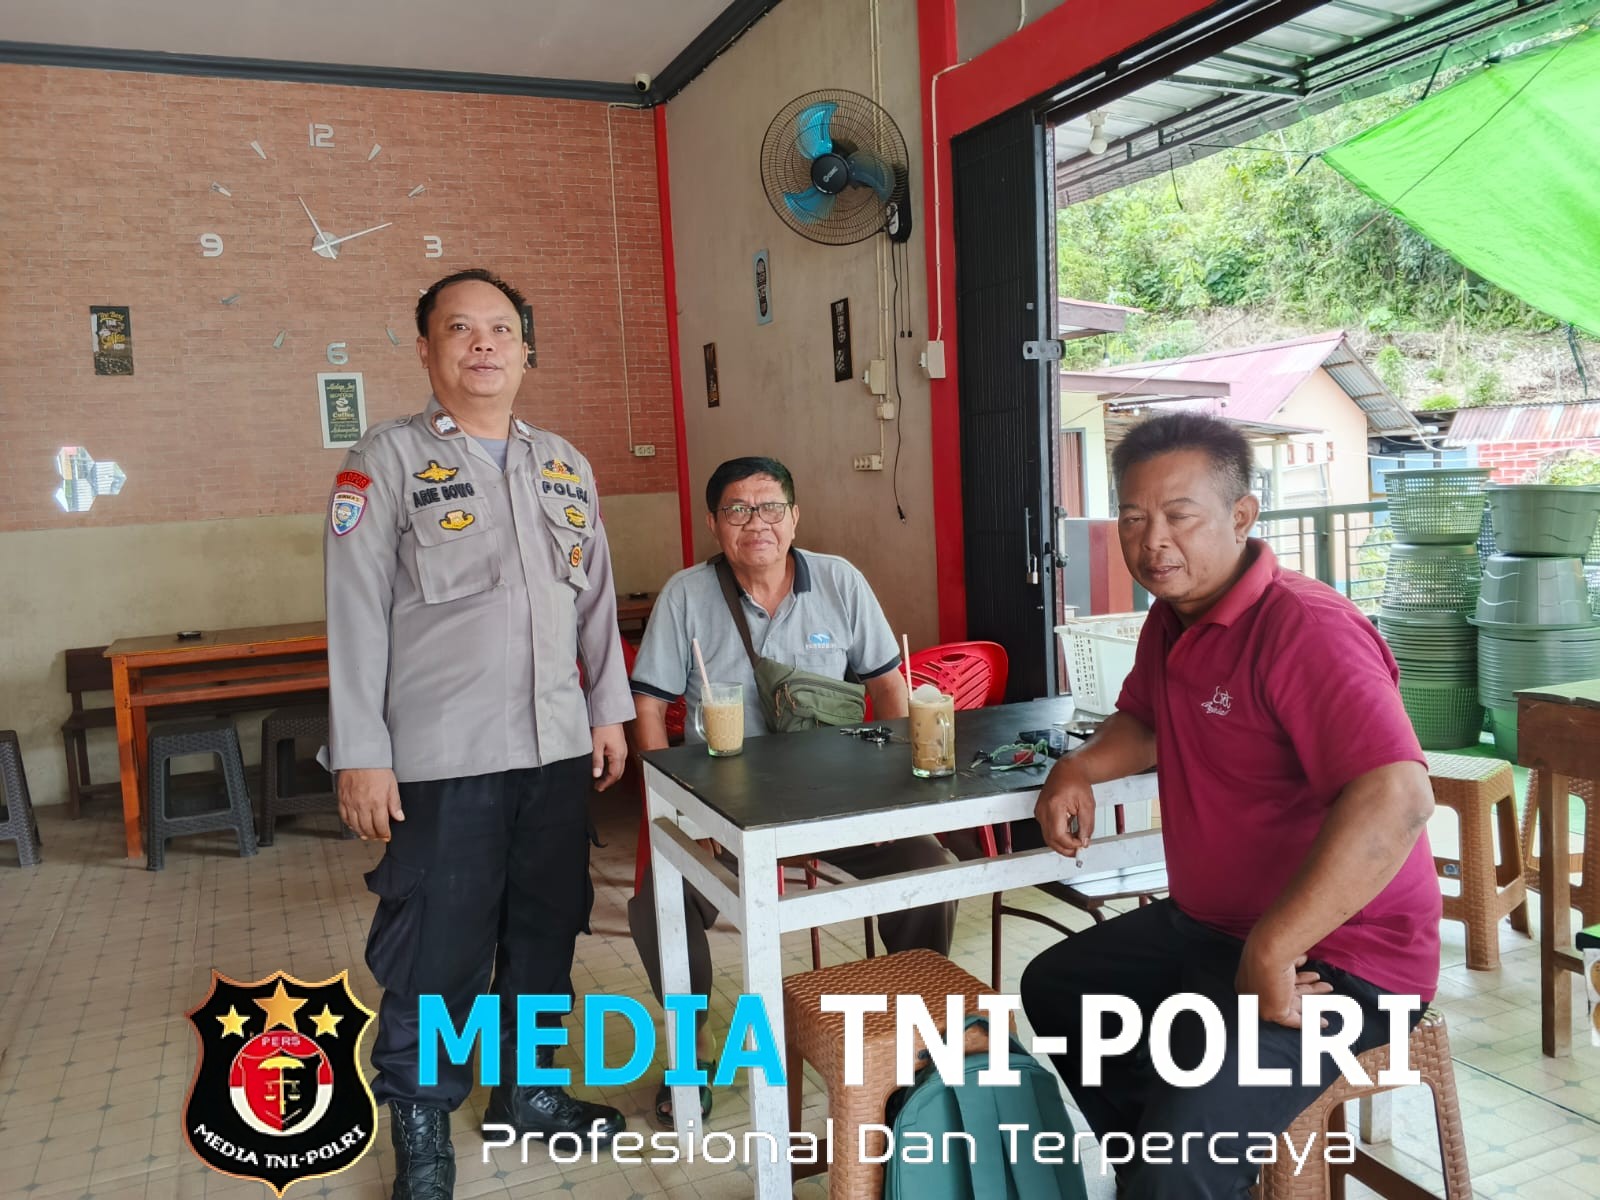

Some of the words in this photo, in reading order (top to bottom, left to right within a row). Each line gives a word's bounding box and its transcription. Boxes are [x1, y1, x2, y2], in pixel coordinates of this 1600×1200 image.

[308, 122, 336, 148] 12
[199, 232, 224, 257] 9
[423, 235, 443, 258] 3
[325, 341, 350, 365] 6
[412, 486, 440, 508] ARIE
[441, 482, 475, 501] BOWO
